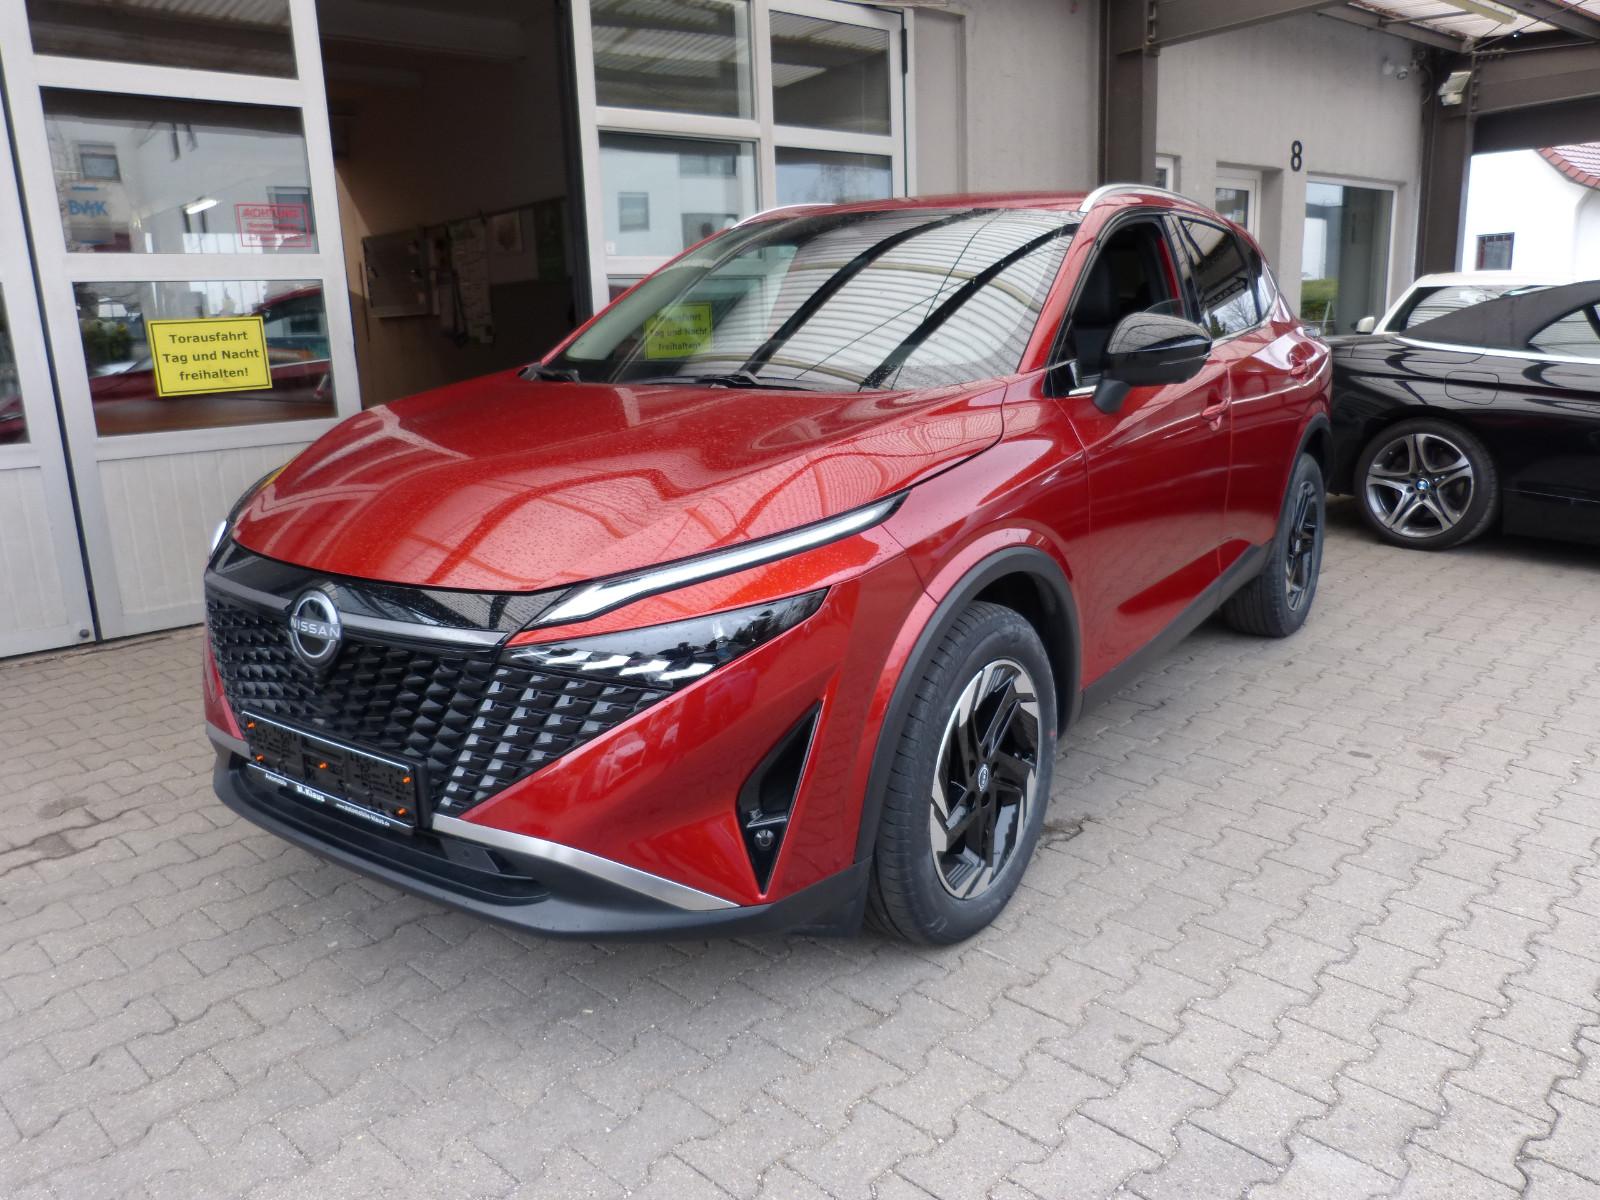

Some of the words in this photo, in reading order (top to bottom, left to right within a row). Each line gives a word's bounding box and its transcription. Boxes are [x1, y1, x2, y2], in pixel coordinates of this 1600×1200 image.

[1291, 140, 1303, 172] 8
[169, 331, 248, 344] Torausfahrt
[162, 353, 188, 365] Tag
[192, 351, 217, 361] und
[222, 348, 260, 360] Nacht
[180, 367, 249, 381] freihalten!
[290, 616, 341, 639] NISSAN
